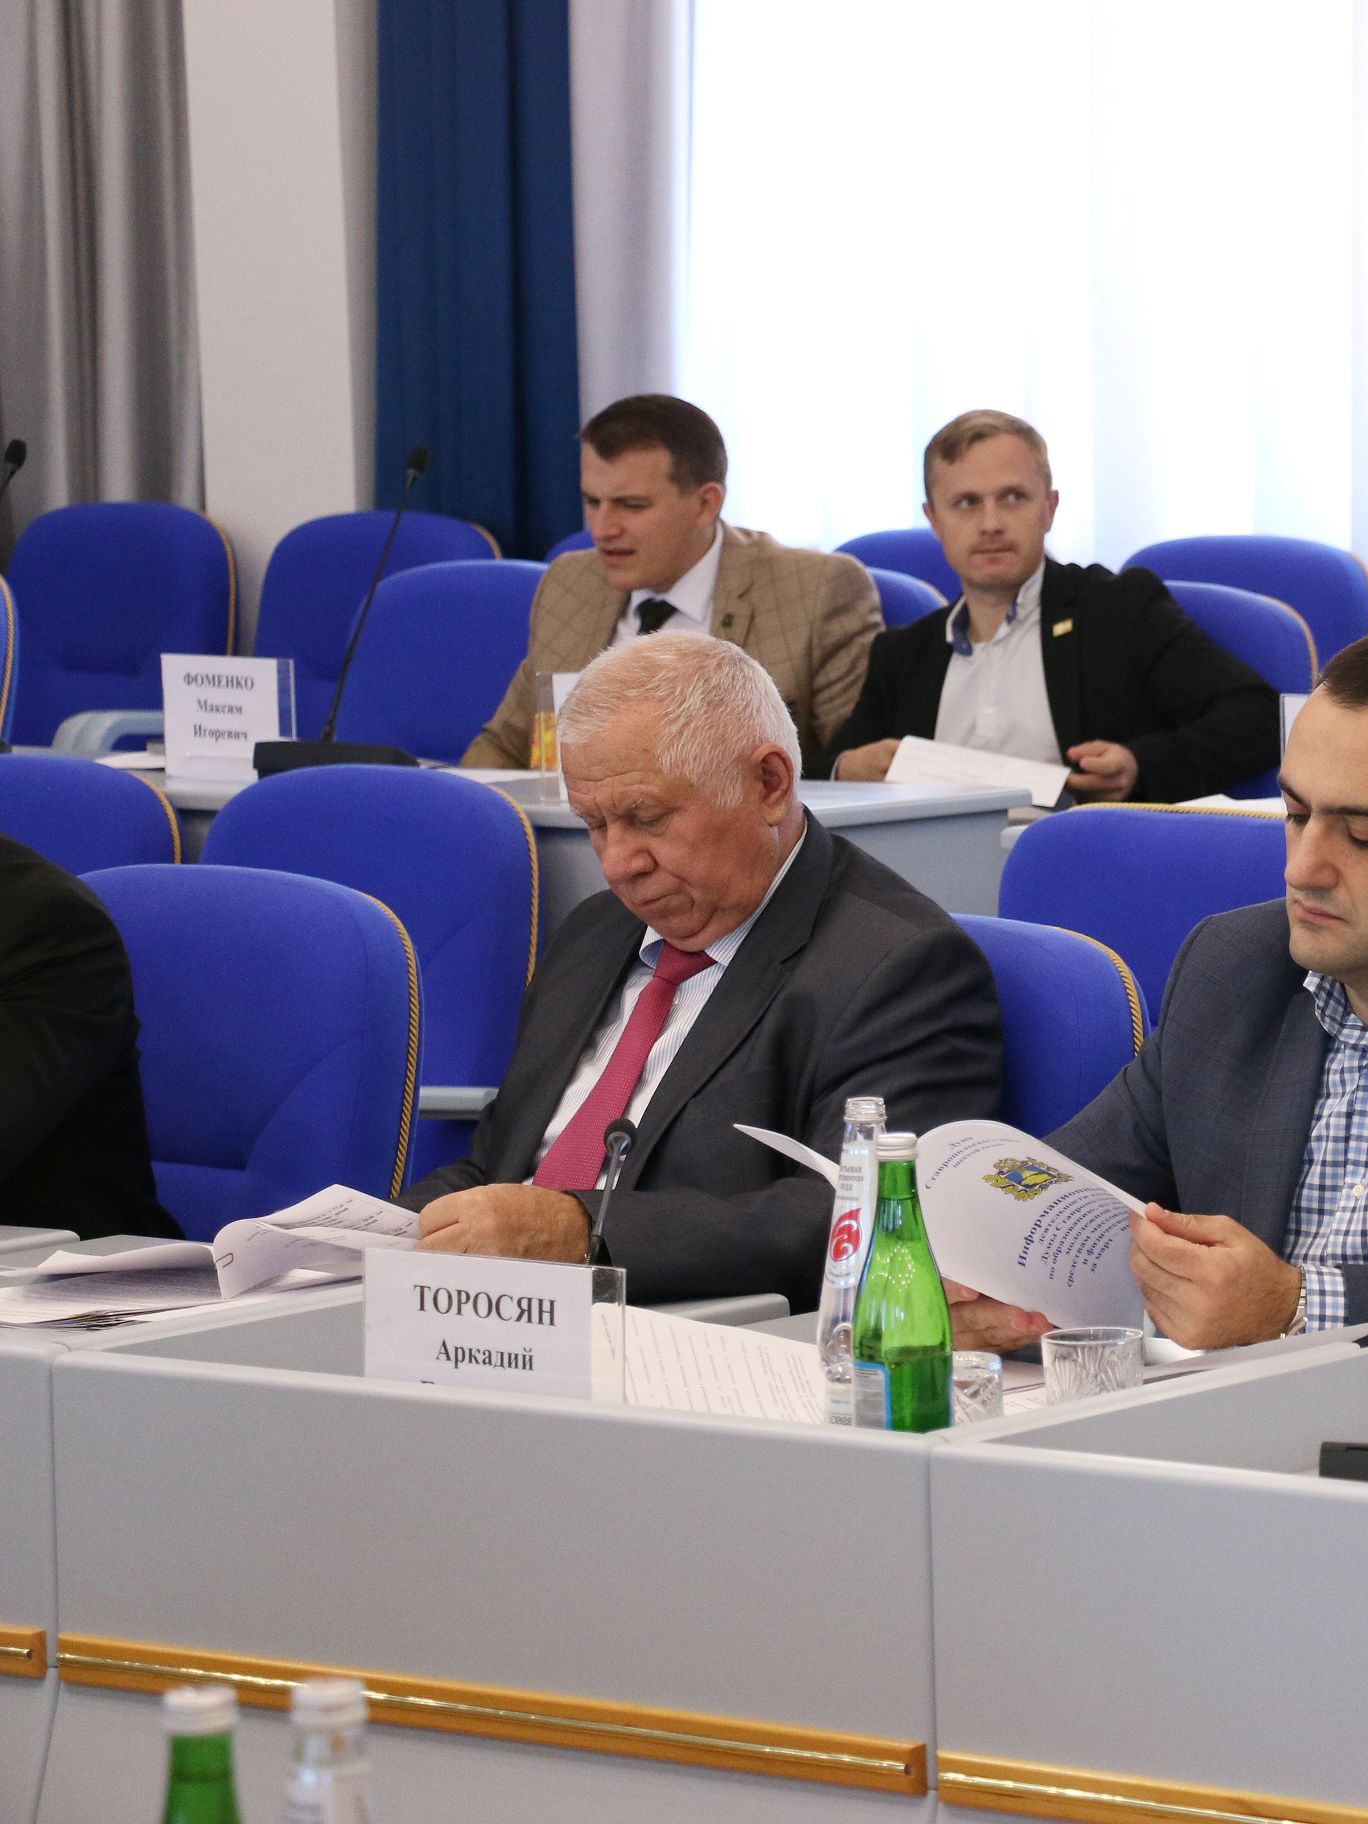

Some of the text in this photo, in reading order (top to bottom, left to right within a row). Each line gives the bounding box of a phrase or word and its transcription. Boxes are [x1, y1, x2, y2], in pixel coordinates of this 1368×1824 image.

[183, 672, 255, 691] ФОМЕНКО
[196, 699, 243, 715] Максим
[193, 724, 248, 742] Игоревич
[413, 1284, 557, 1327] ТОРОСЯН
[436, 1338, 535, 1372] Аркадий
